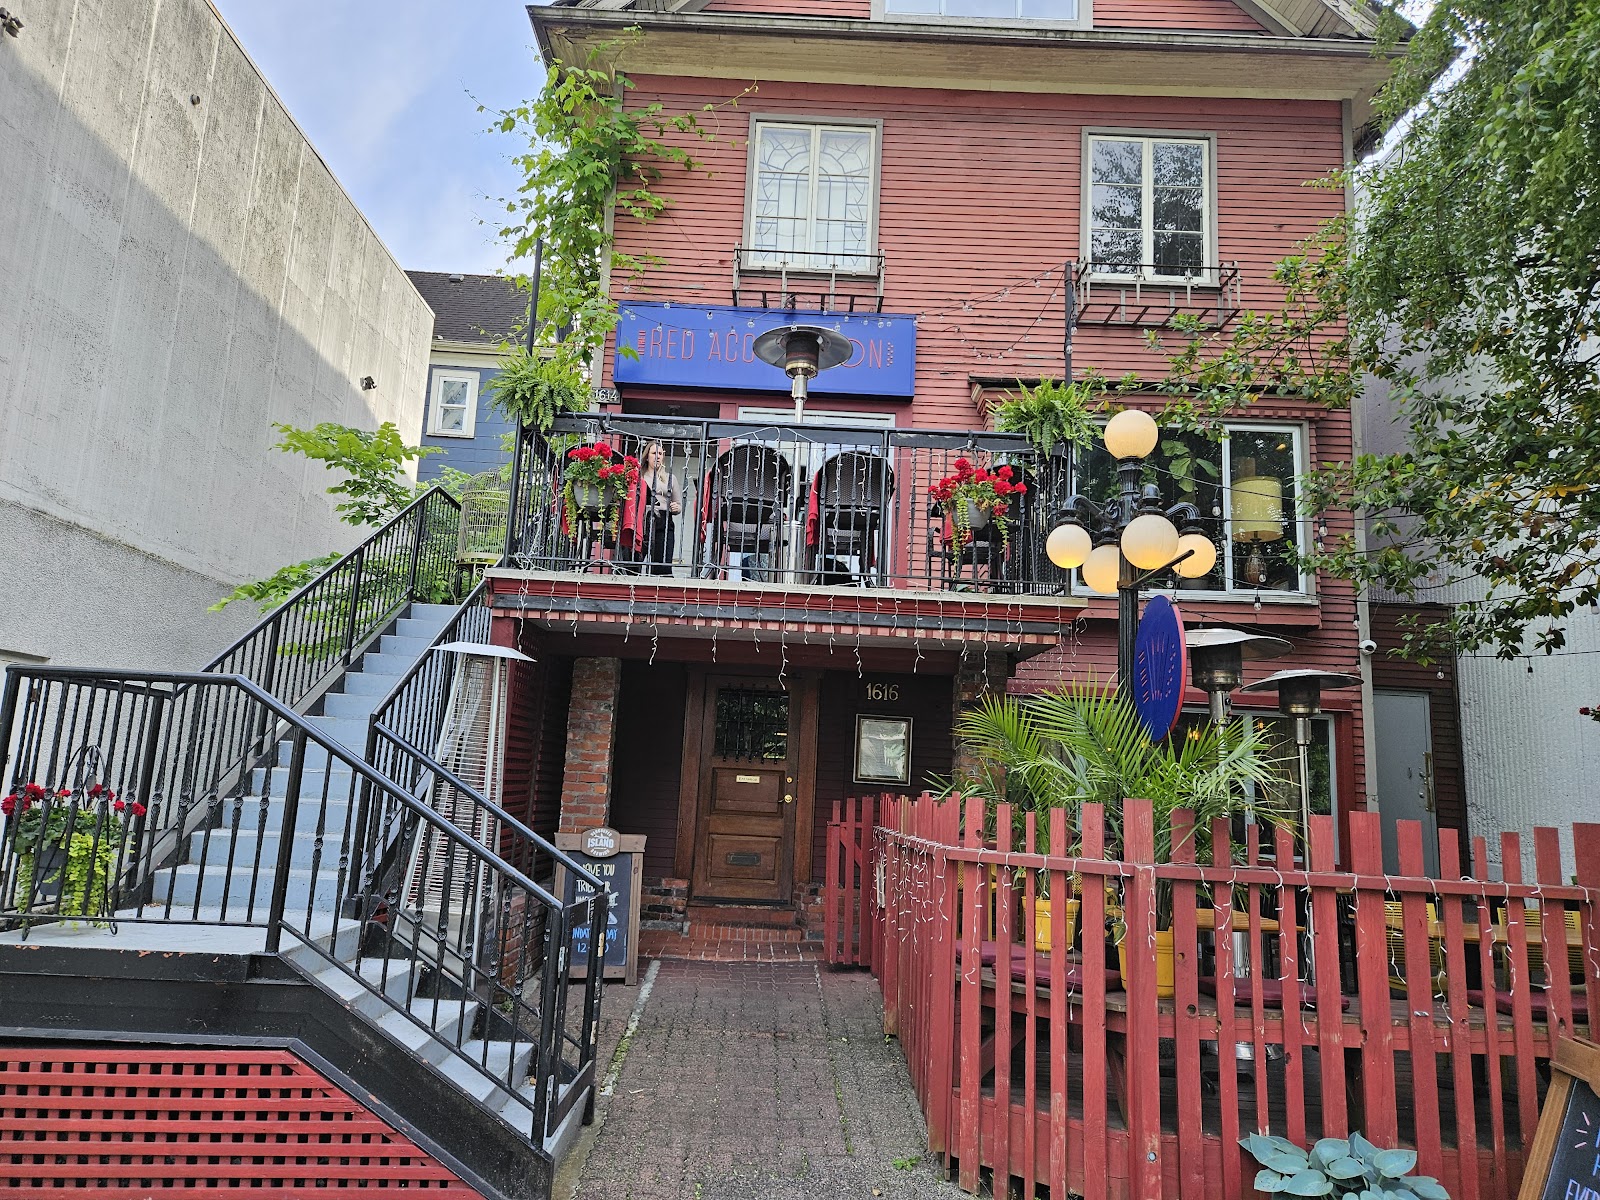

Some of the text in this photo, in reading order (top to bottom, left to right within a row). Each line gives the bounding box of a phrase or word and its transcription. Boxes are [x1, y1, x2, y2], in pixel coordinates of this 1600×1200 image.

[650, 328, 882, 369] RED ACCON
[594, 389, 618, 401] 1614
[866, 682, 899, 701] 1616
[587, 838, 614, 849] ISLAND
[602, 863, 615, 876] YOU
